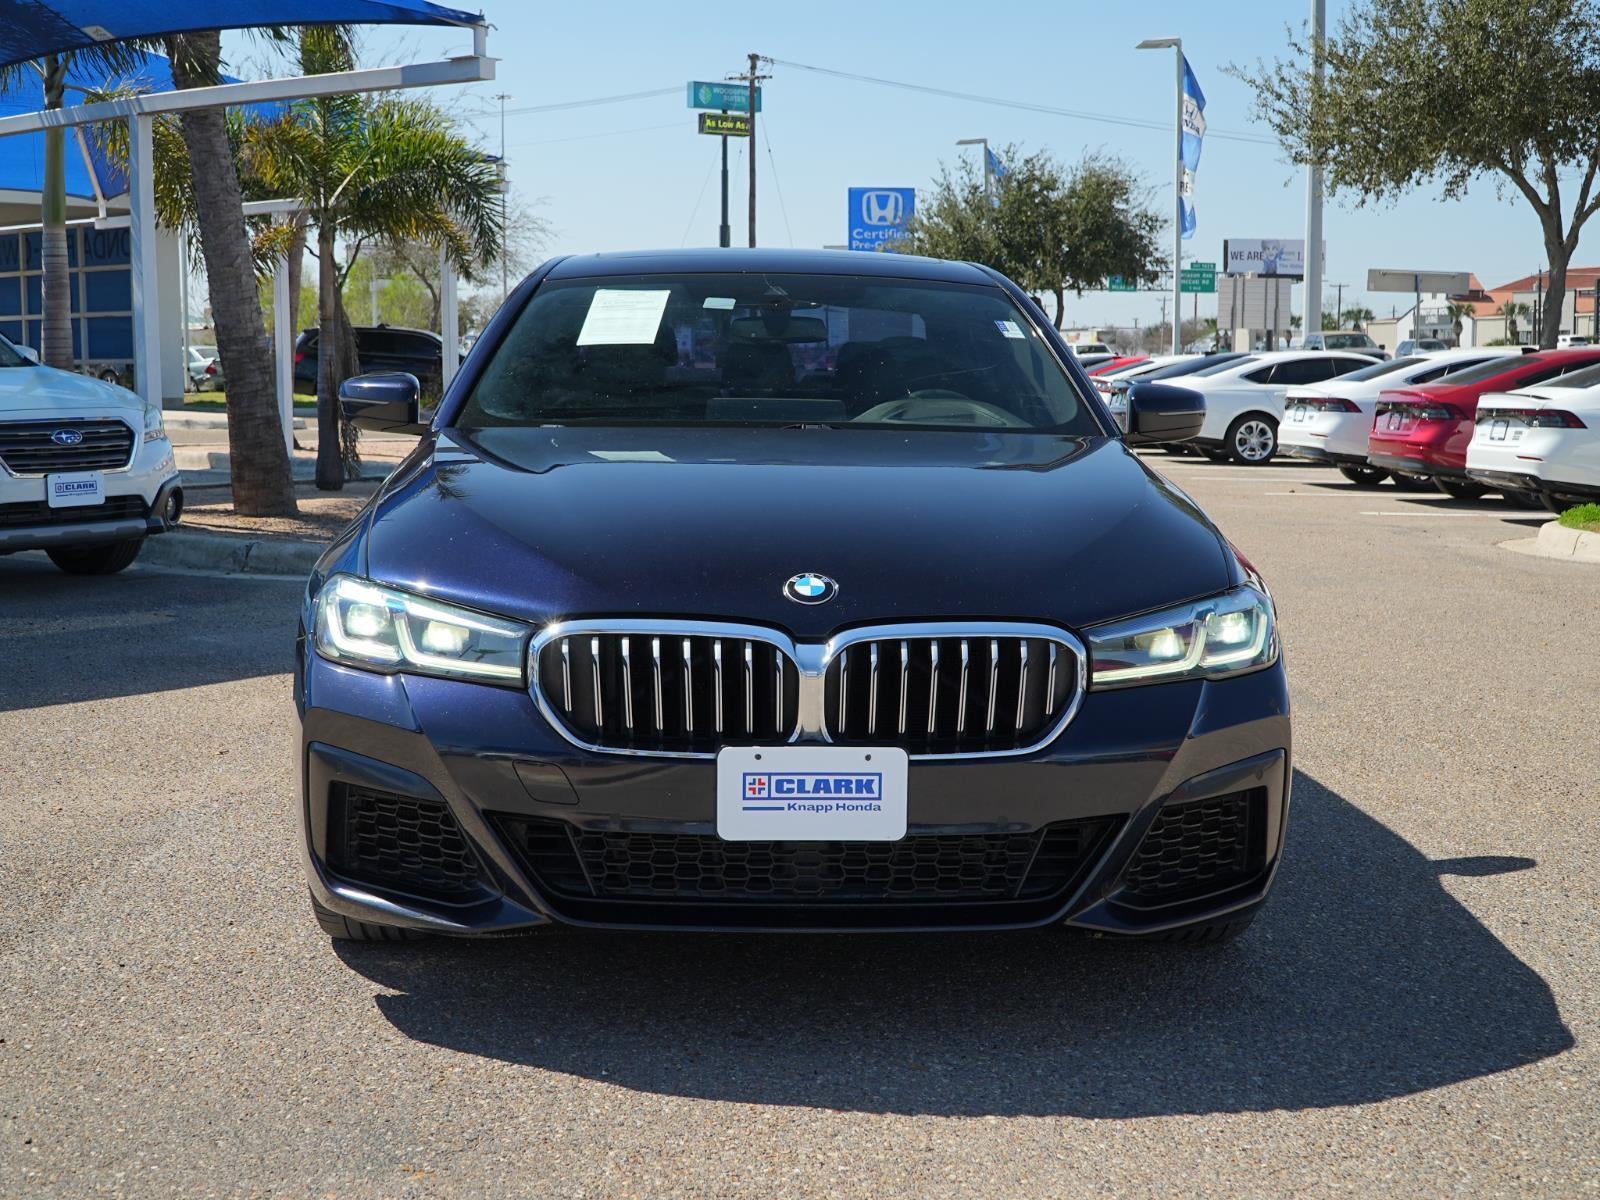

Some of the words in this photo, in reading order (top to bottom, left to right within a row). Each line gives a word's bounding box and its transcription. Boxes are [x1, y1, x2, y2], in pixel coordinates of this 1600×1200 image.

[718, 121, 734, 129] Low
[736, 122, 746, 130] As
[1230, 251, 1245, 261] WE
[1246, 251, 1265, 261] ARE
[64, 483, 95, 491] CLARK
[774, 778, 876, 795] CLARK
[787, 803, 833, 813] Knapp
[836, 802, 882, 812] Honda
